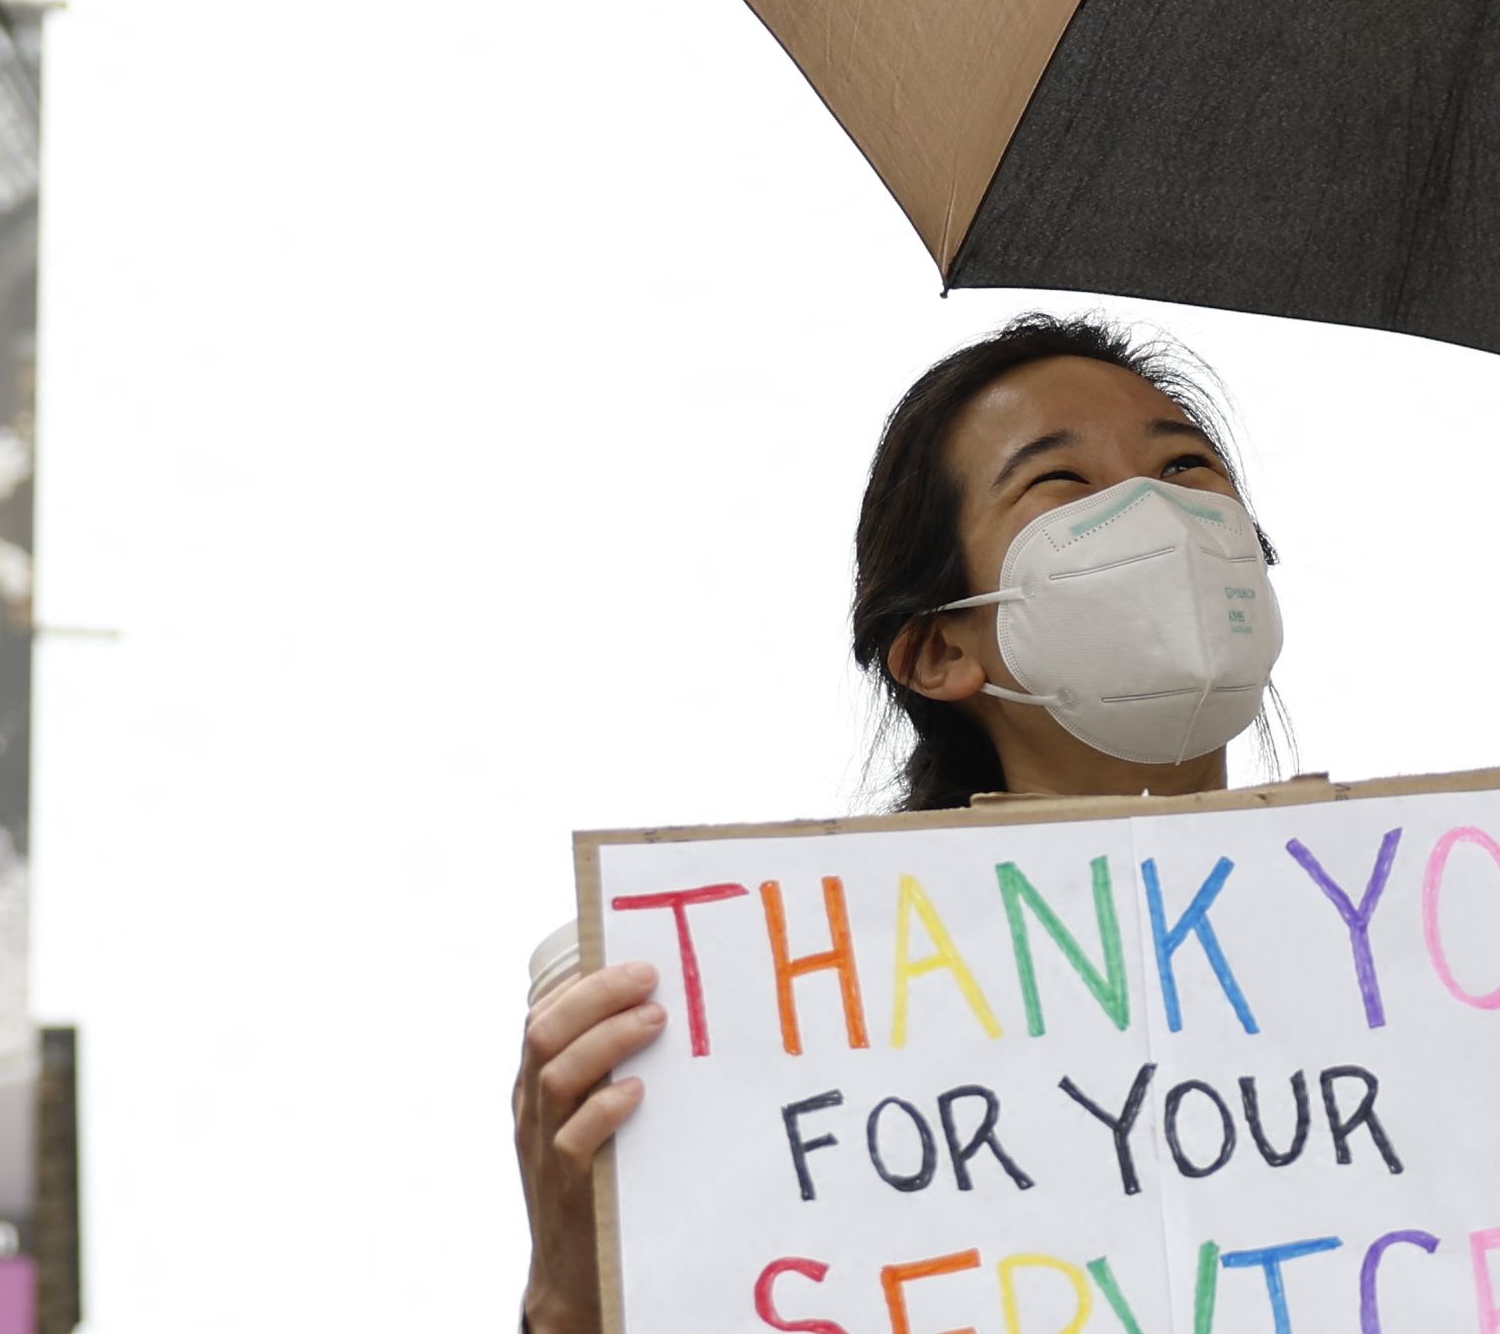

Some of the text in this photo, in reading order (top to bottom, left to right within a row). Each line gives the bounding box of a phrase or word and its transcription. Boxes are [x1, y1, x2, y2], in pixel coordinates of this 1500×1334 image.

[610, 854, 1263, 1059] THANK
[781, 1062, 1406, 1202] FOR YOUR
